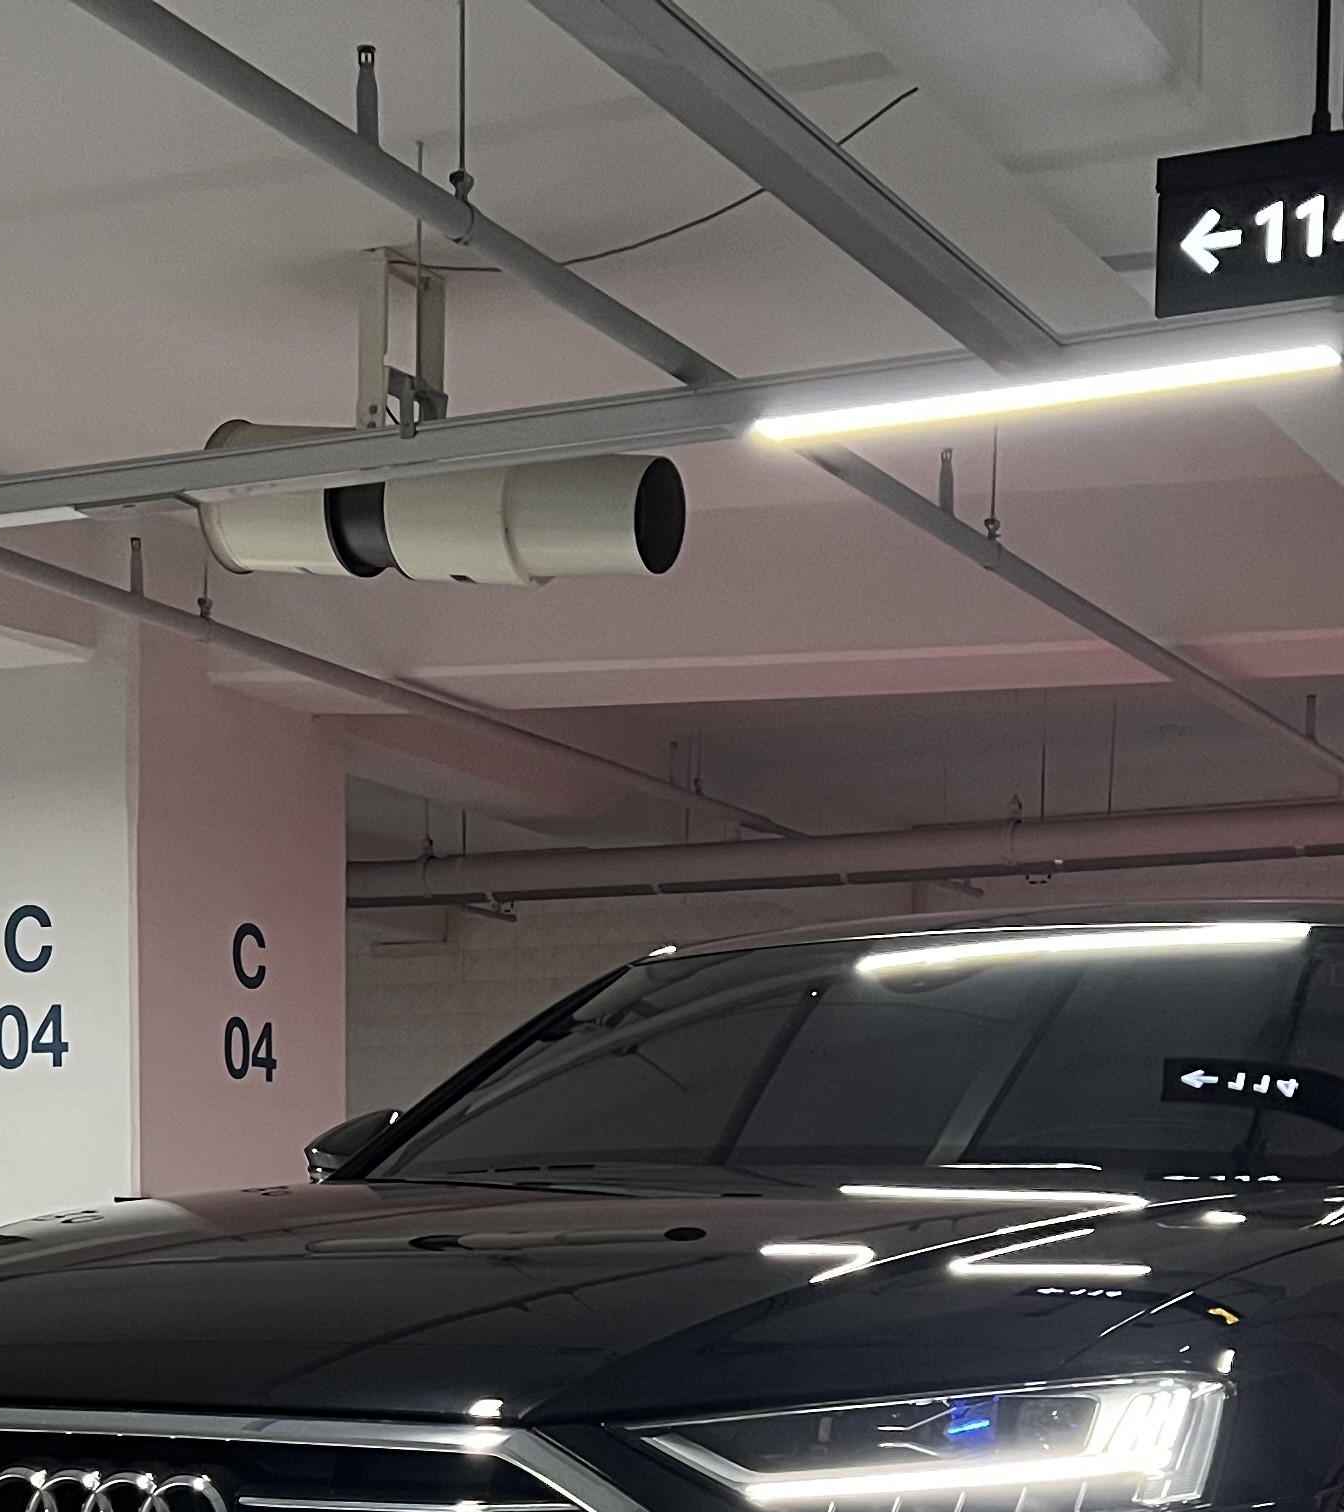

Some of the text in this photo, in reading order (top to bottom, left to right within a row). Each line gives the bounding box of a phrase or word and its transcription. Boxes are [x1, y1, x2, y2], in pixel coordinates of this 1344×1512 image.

[4, 904, 53, 973] C
[233, 922, 267, 990] C
[224, 1016, 278, 1082] 04
